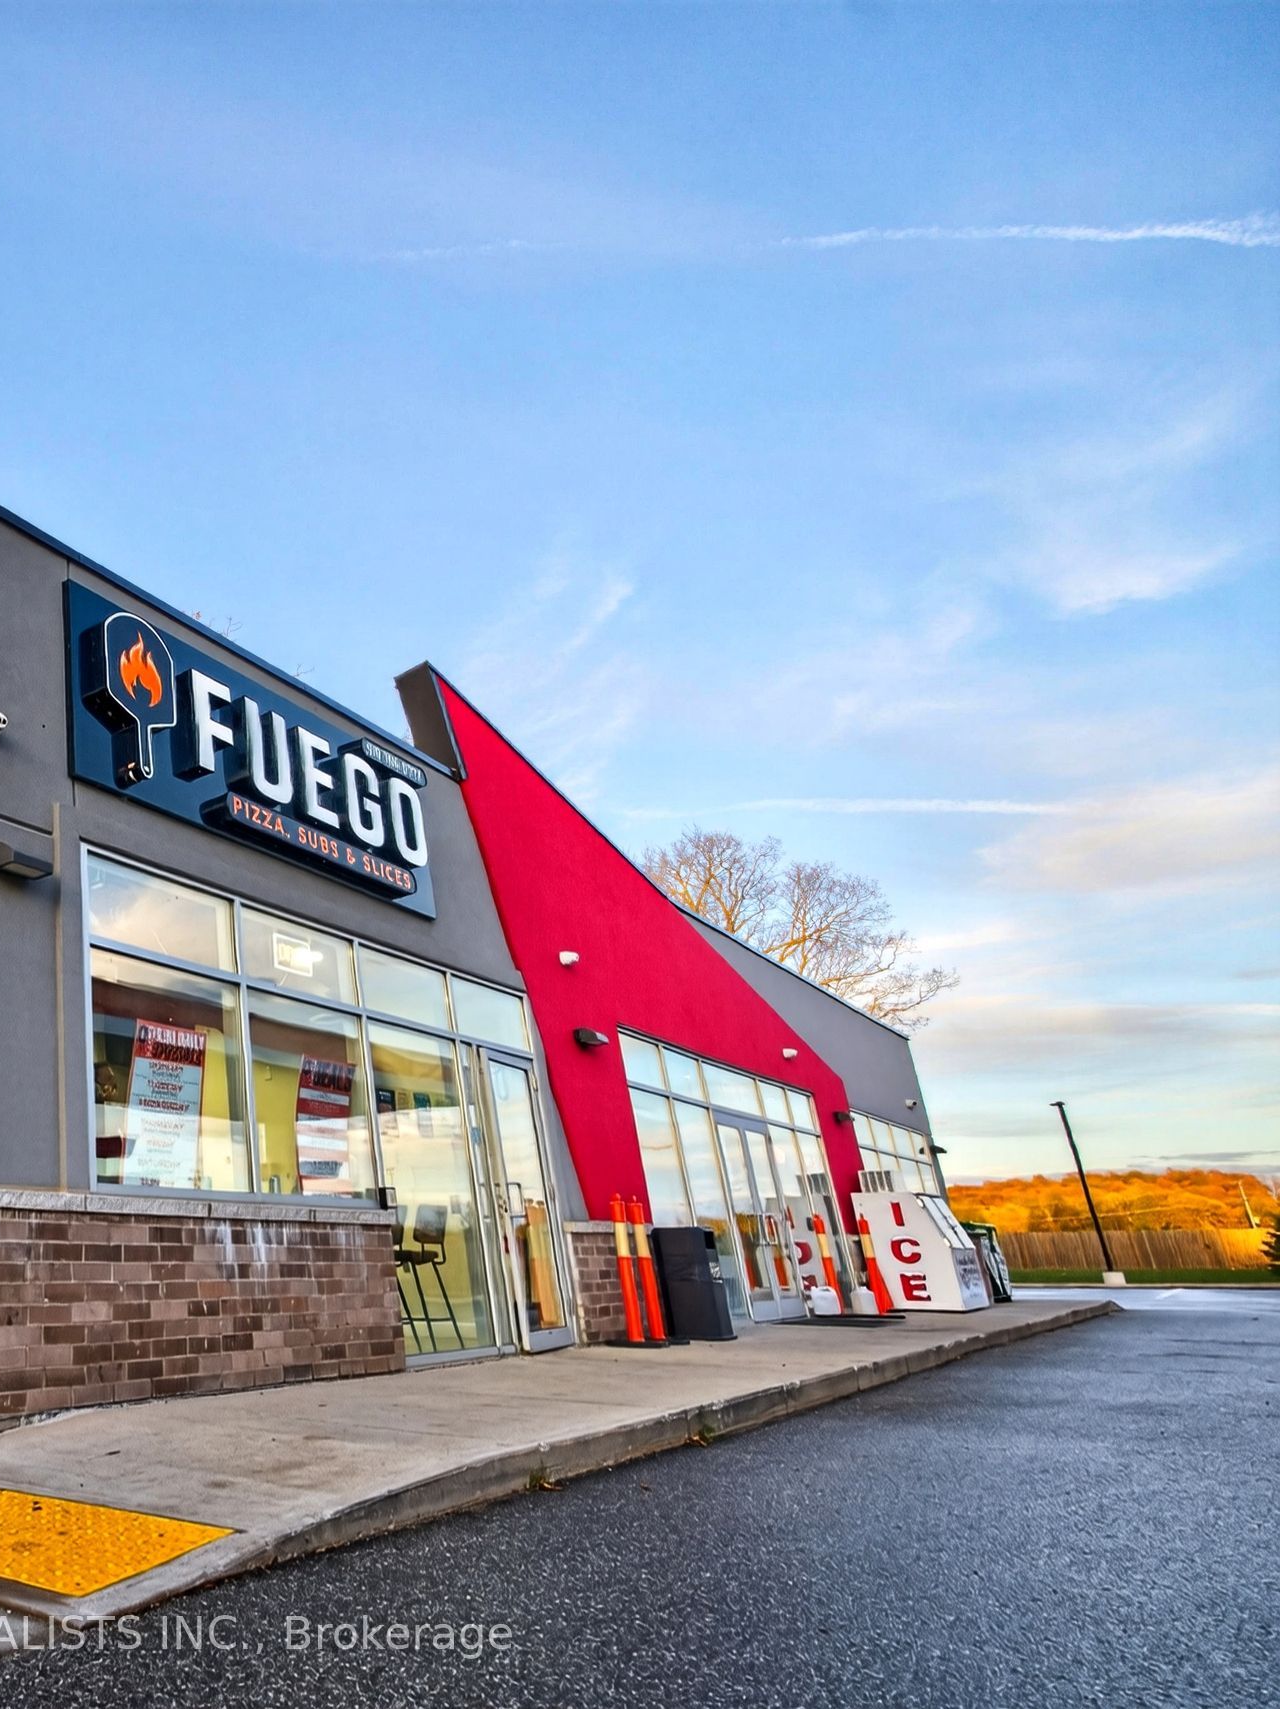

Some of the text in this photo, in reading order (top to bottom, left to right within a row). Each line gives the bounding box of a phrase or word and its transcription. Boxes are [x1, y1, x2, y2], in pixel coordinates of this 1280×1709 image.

[191, 668, 428, 867] FUEGO
[298, 826, 339, 858] SUBS
[346, 847, 356, 864] &
[363, 856, 412, 889] SLICES
[889, 1201, 932, 1302] ICE
